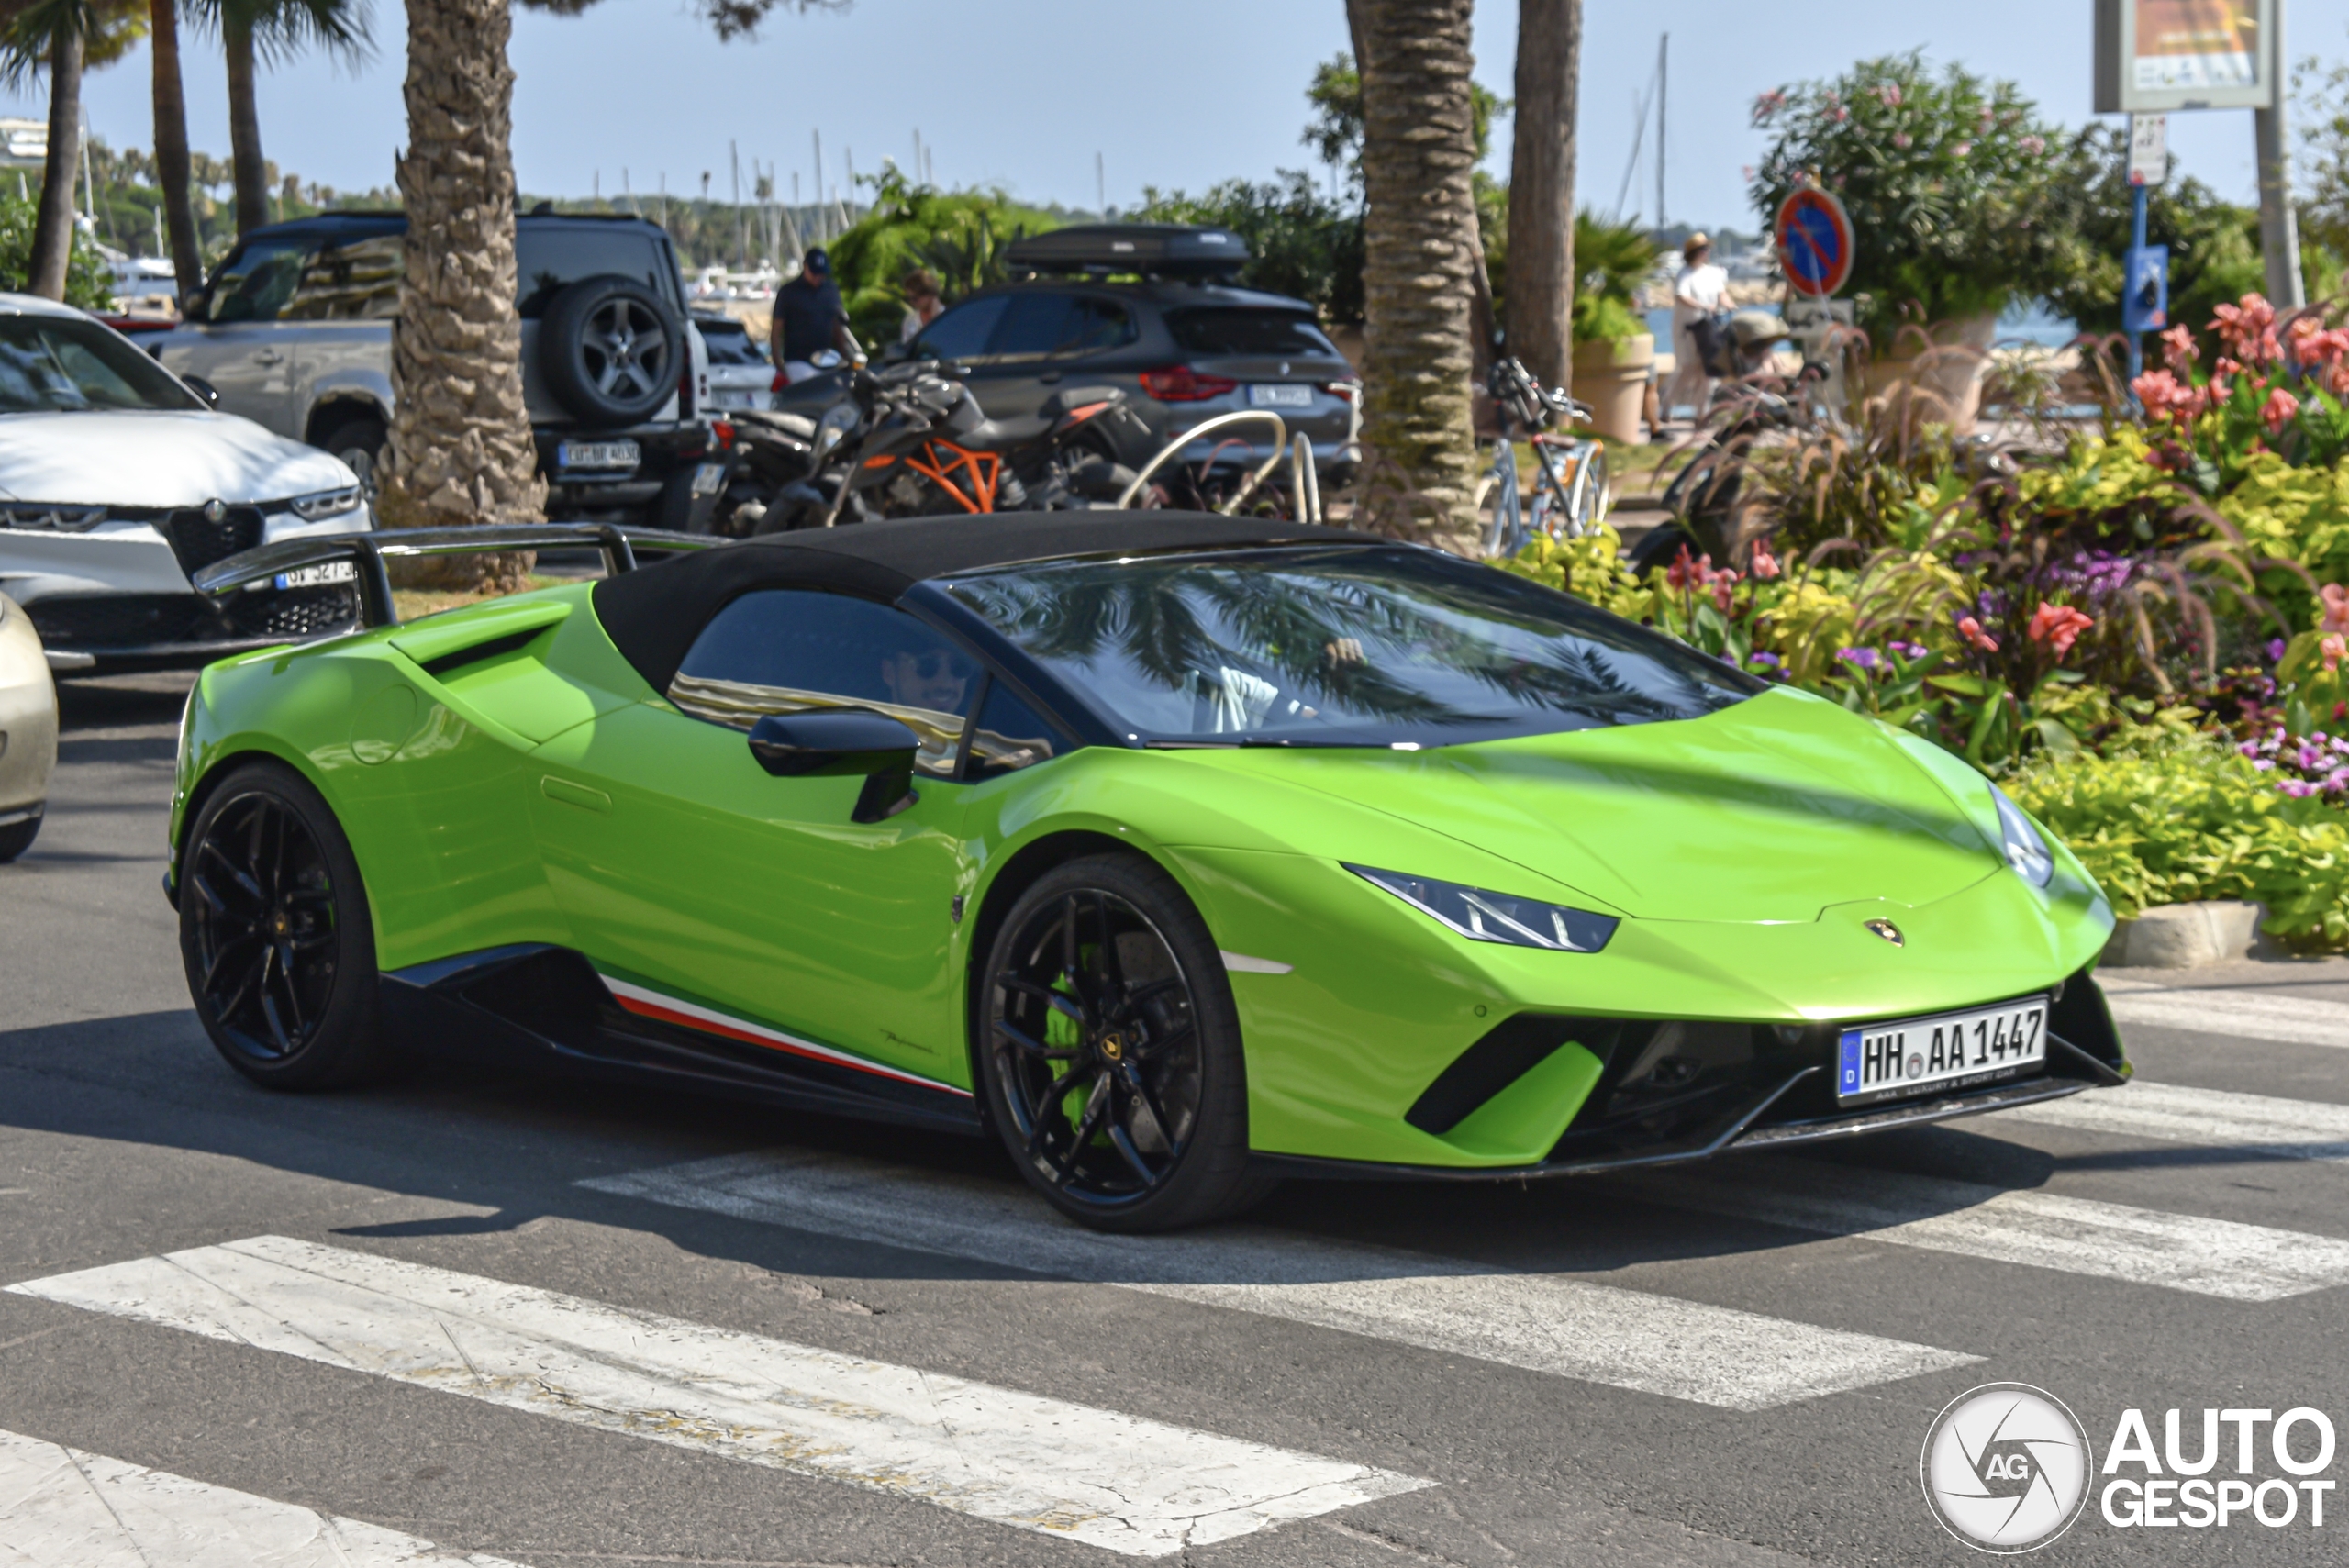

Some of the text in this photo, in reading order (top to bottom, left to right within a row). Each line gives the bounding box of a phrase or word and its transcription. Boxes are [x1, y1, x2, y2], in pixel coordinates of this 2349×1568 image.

[1864, 1007, 2044, 1084] HH AA 1447
[1845, 1069, 1855, 1084] D
[1906, 1081, 1948, 1095] LUXURY
[1950, 1079, 1959, 1088] &
[1960, 1072, 1994, 1086] SPORT
[1995, 1068, 2017, 1079] CAR
